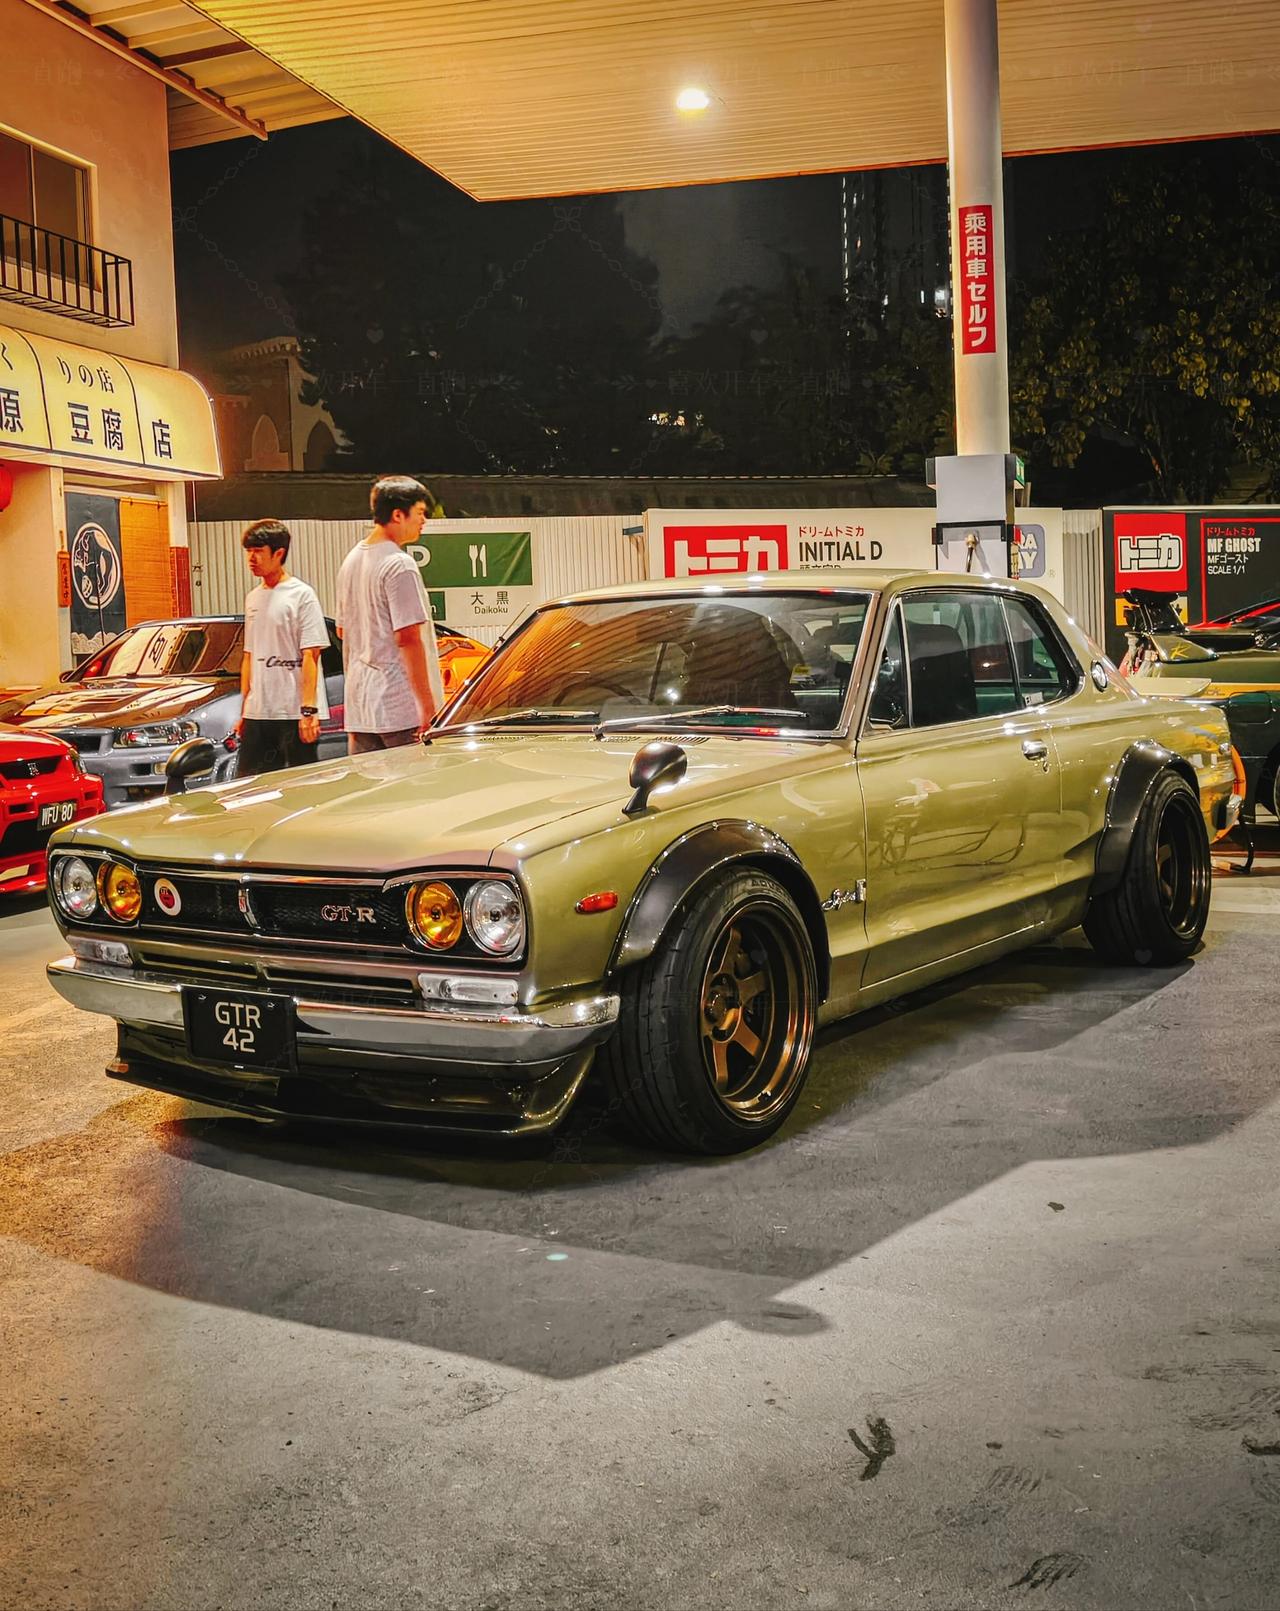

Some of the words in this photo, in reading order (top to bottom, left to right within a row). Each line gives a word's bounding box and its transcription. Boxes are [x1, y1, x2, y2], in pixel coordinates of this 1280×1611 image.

[965, 212, 988, 347] 乗用車セルフ
[800, 541, 865, 562] INITIAL
[870, 541, 883, 561] D
[1118, 533, 1183, 573] トミカ
[1207, 539, 1223, 553] MF
[1225, 537, 1262, 553] GHOST
[1207, 554, 1249, 564] MFゴースト
[1207, 565, 1232, 575] SCALE
[1233, 565, 1246, 575] 1/1
[474, 605, 508, 615] Daikoku
[42, 805, 59, 826] WFU
[61, 803, 73, 822] 80
[321, 904, 377, 924] GT-R
[215, 1001, 262, 1029] GTR
[223, 1027, 256, 1053] 42
